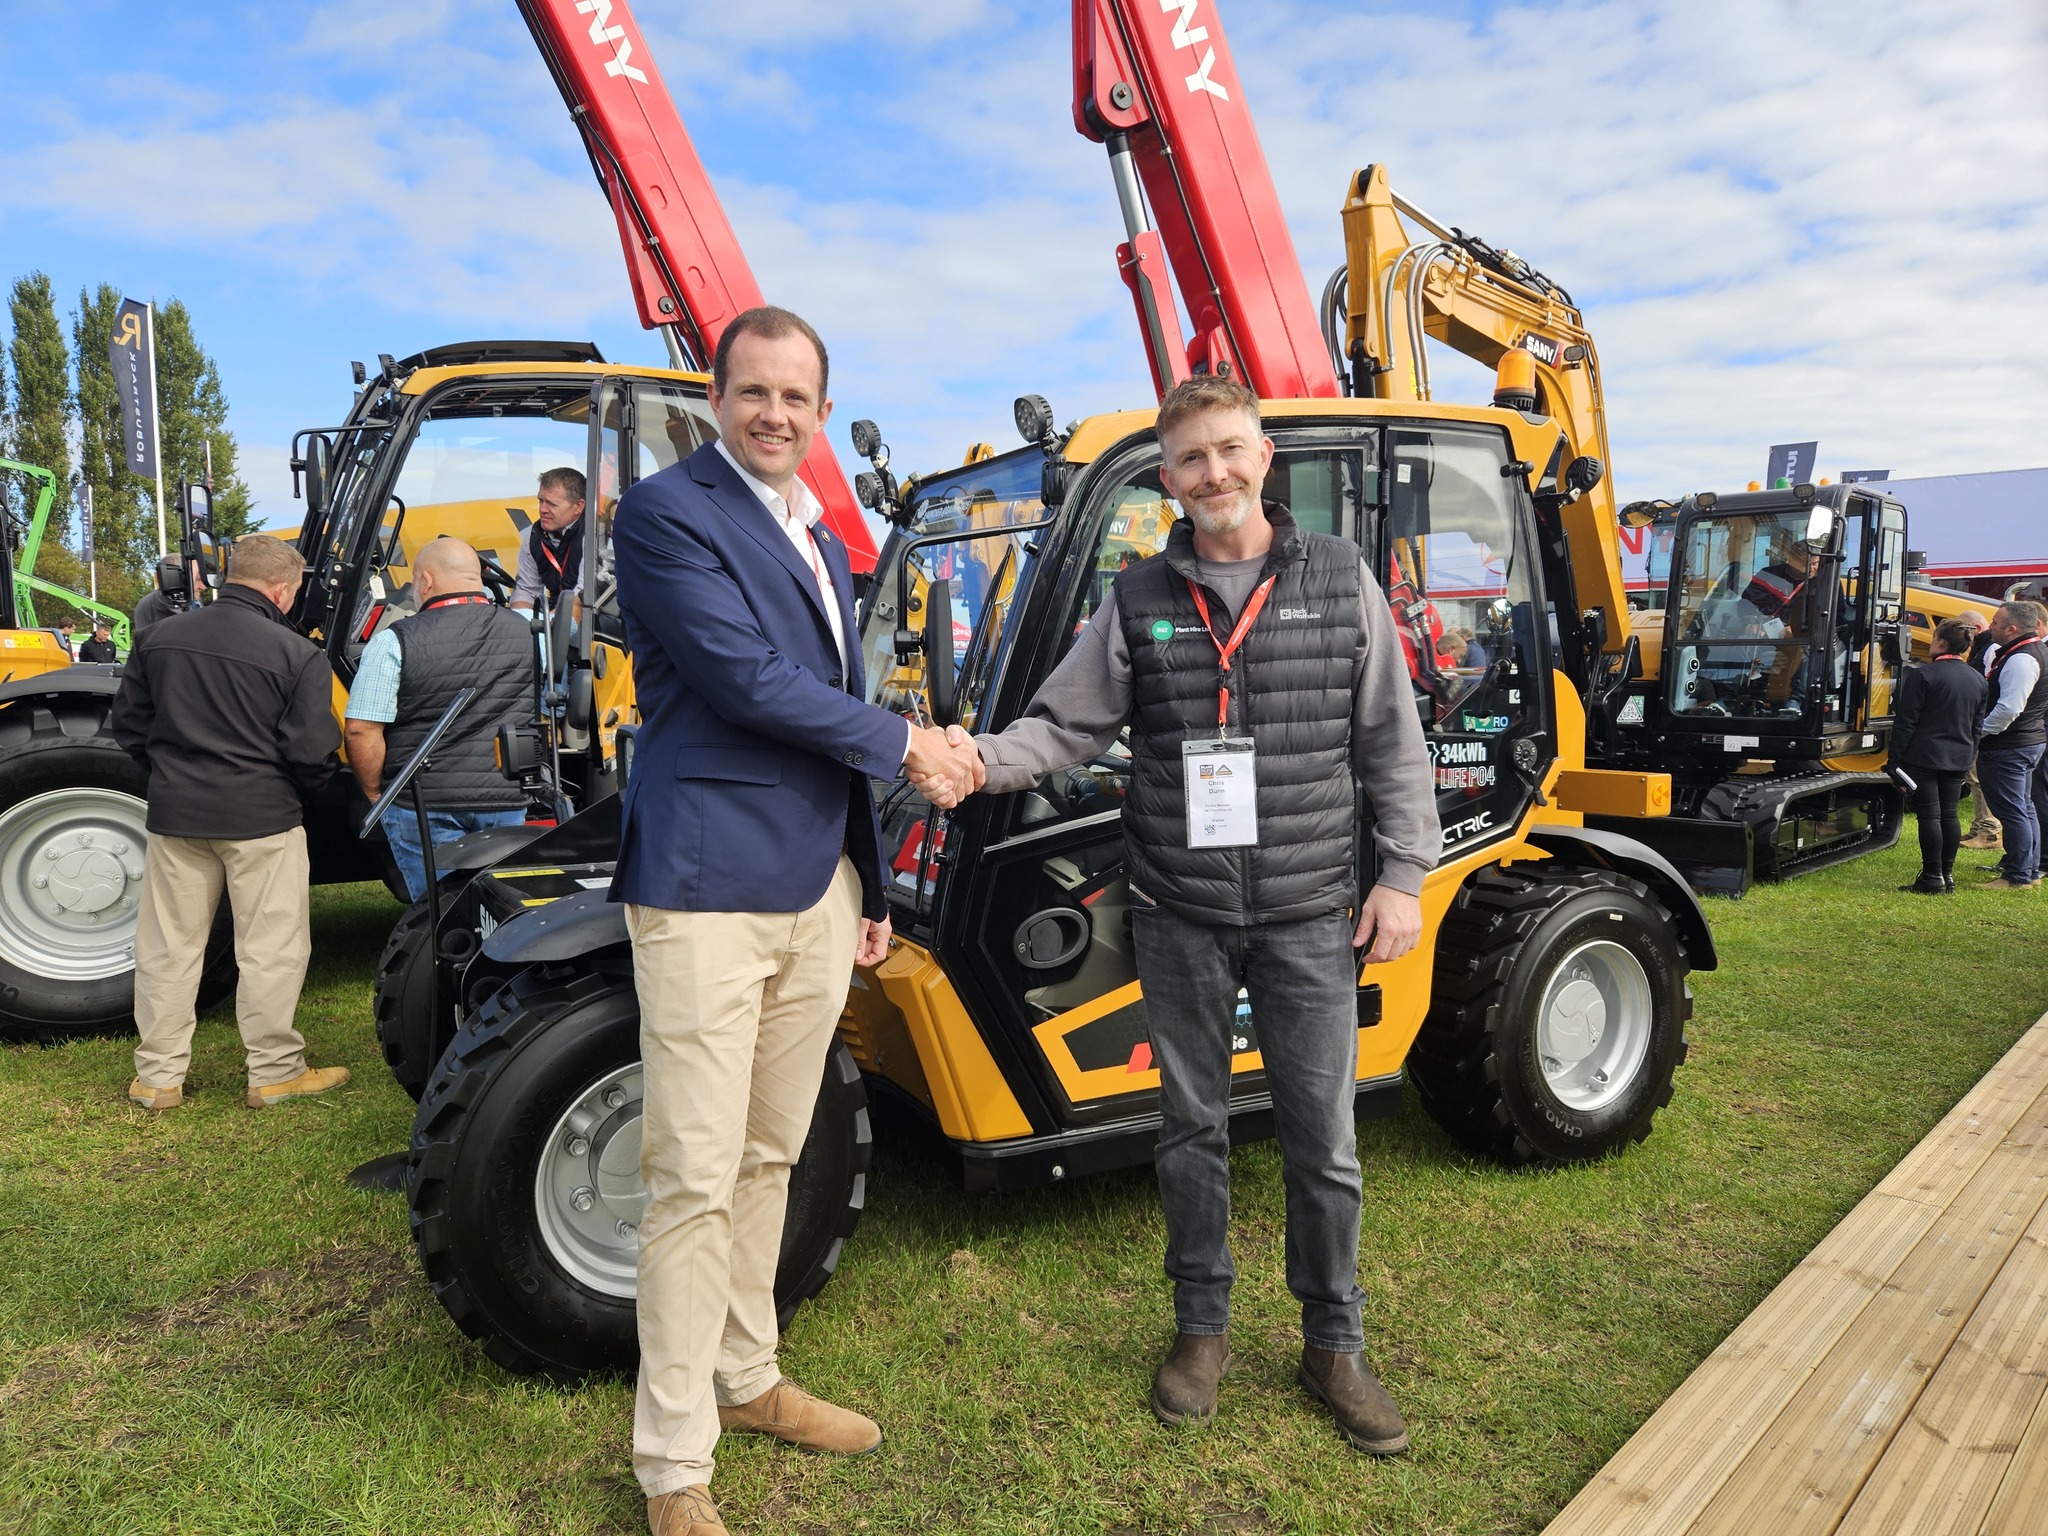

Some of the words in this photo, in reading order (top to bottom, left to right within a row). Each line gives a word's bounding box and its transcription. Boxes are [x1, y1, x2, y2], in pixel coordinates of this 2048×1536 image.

[1526, 335, 1554, 363] SANY
[1440, 742, 1487, 764] 34kWh
[1440, 767, 1467, 789] LIFE
